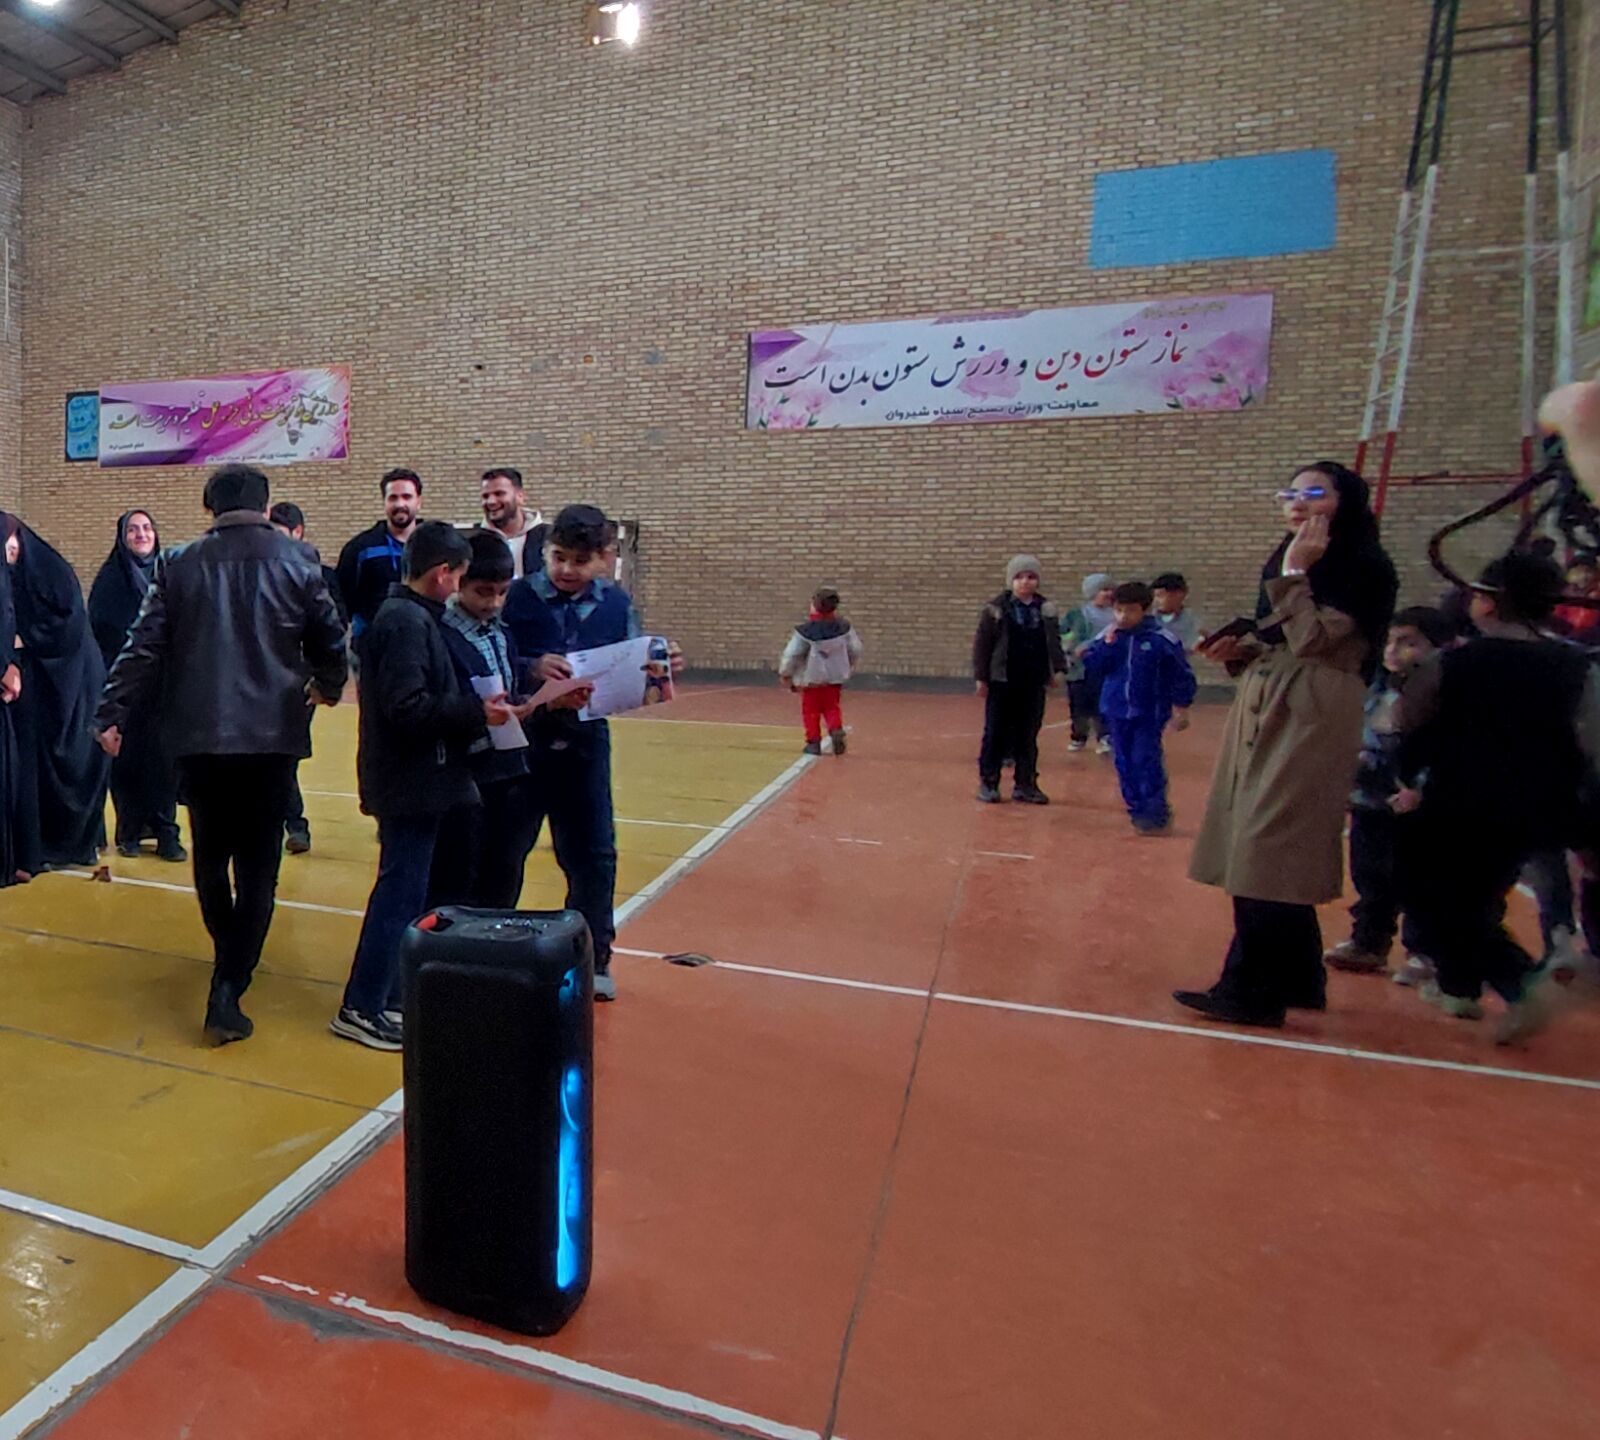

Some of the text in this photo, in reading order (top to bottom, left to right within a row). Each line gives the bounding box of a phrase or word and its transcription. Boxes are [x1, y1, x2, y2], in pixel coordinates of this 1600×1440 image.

[764, 322, 1189, 406] نماز ستون دین و ورزش ستون بدن است
